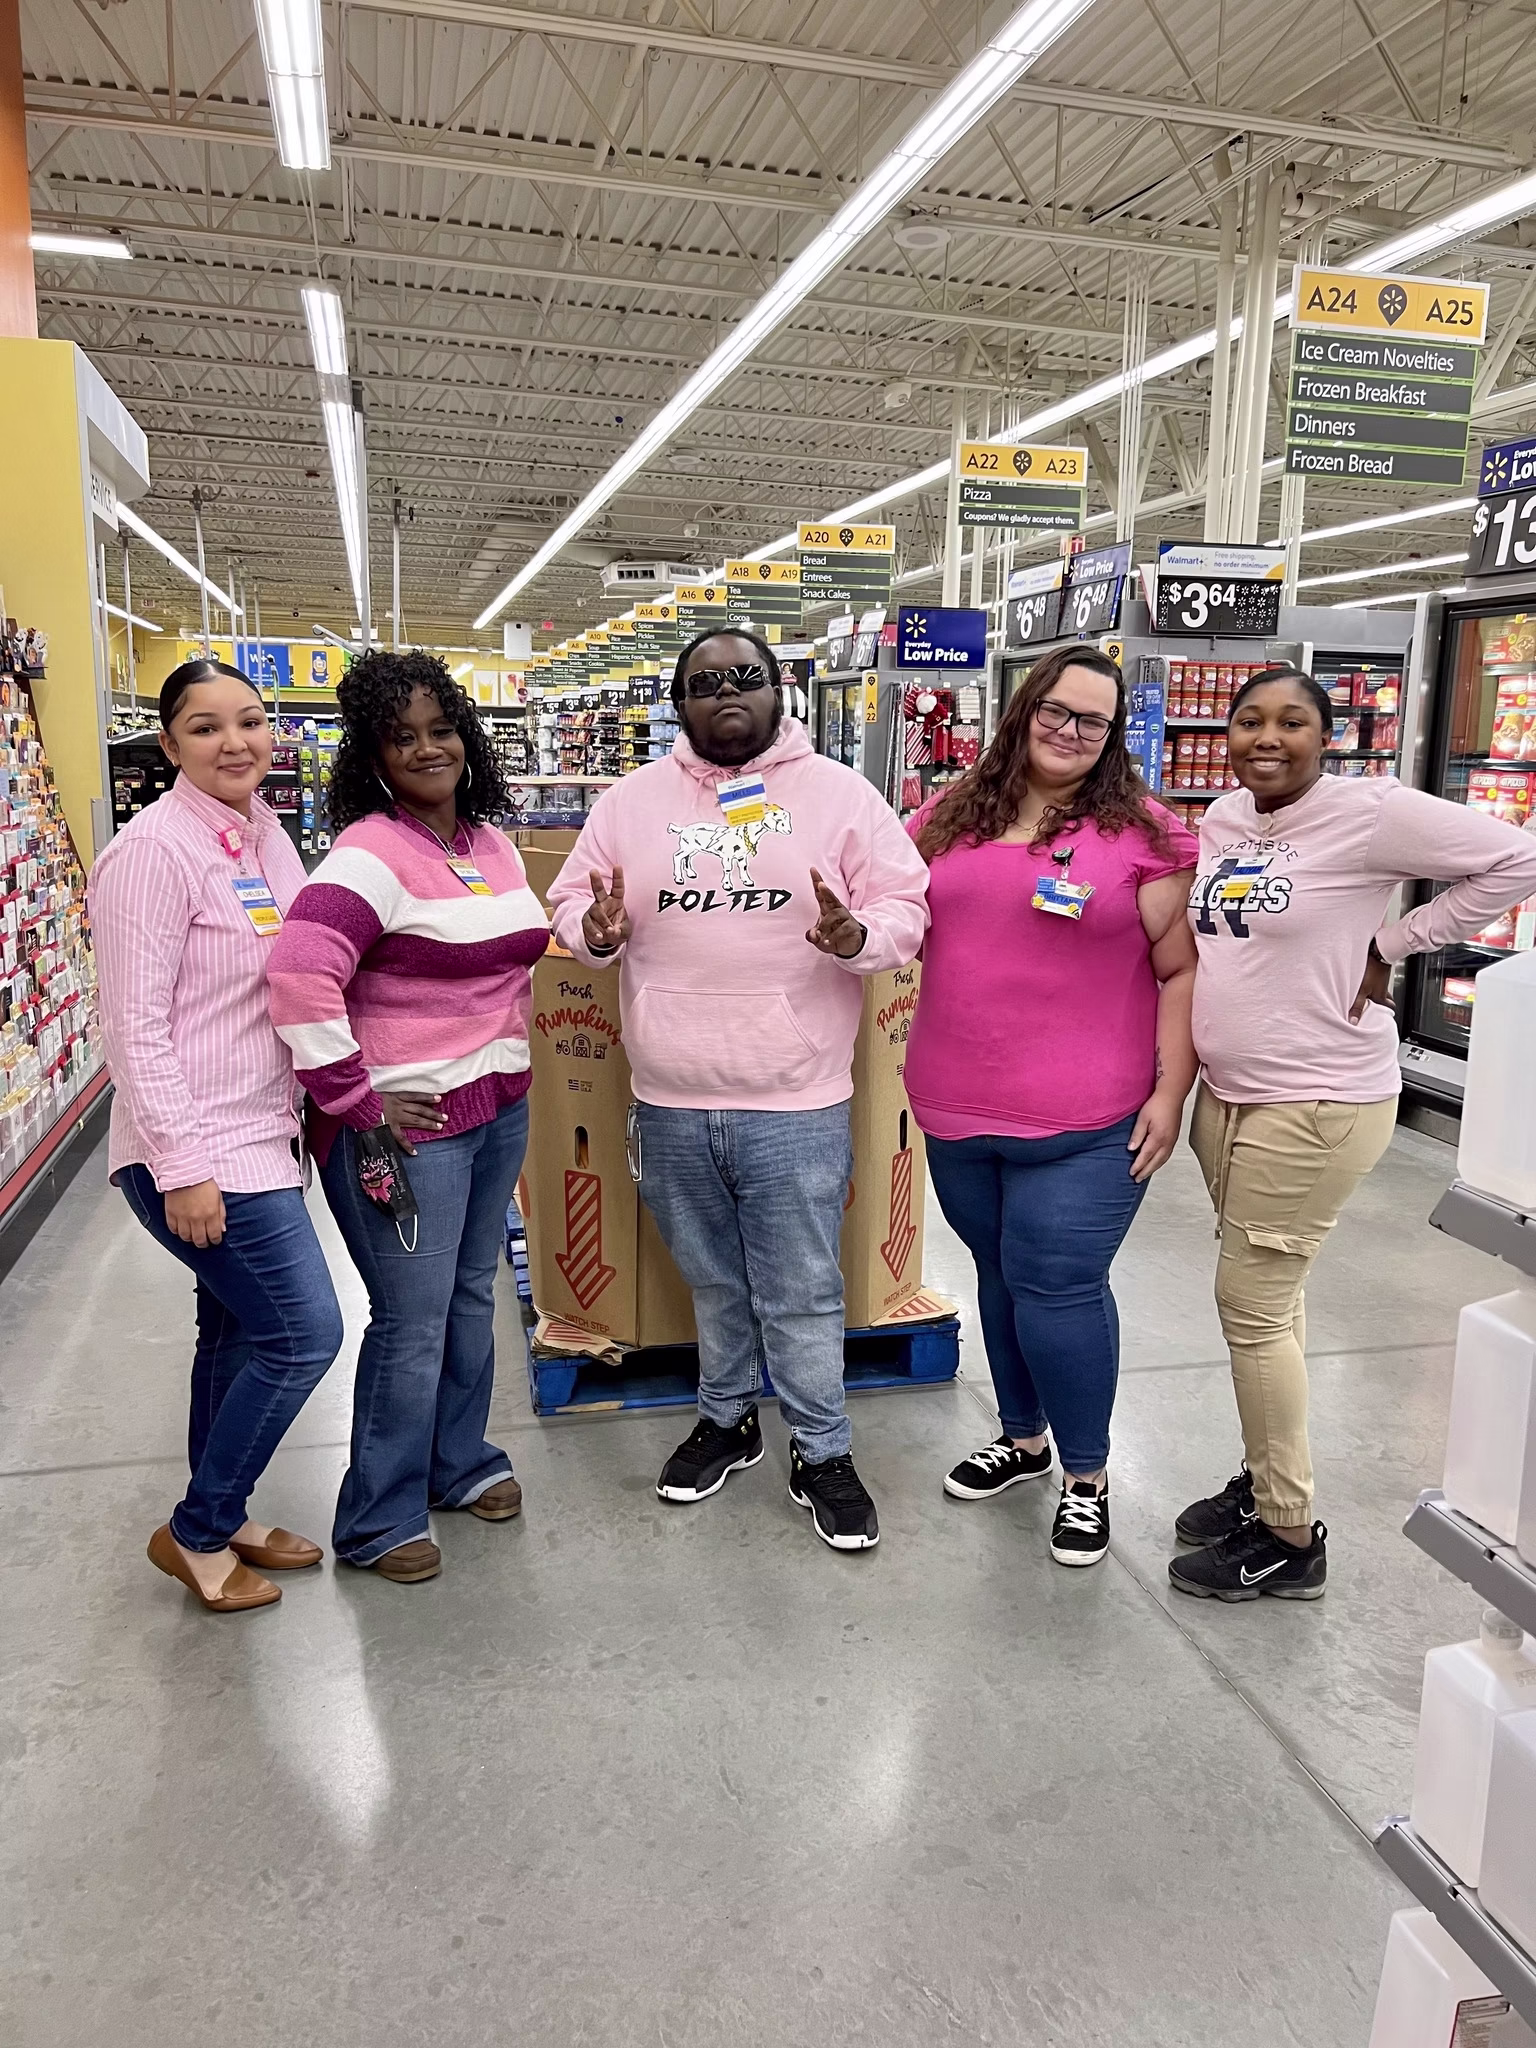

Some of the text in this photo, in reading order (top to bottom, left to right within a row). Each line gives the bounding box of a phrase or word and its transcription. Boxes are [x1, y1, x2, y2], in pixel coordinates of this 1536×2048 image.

[1306, 286, 1474, 325] A24 A25
[1301, 340, 1454, 371] Ice Cream Novelties
[1298, 377, 1426, 405] Frozen Breakfast
[1295, 413, 1356, 436] Dinners
[966, 453, 1076, 474] A22 A23
[1292, 450, 1393, 475] Frozen Bread
[964, 488, 992, 500] Pizza
[964, 512, 996, 521] Coupons?
[1010, 514, 1031, 524] gladly
[1032, 516, 1054, 524] accept
[1055, 516, 1074, 524] them.
[805, 531, 886, 545] A20 A21
[803, 556, 826, 565] Bread
[732, 568, 797, 579] A18 A19
[1080, 561, 1114, 578] Low Price
[803, 573, 832, 582] Entrees
[681, 591, 696, 599] A16
[803, 589, 850, 599] Snack Cakes
[729, 614, 750, 622] Cocoa
[905, 641, 931, 650] Everyday
[904, 649, 968, 662] Low Price
[868, 702, 875, 710] A
[657, 889, 792, 912] BOLTED
[893, 969, 913, 988] Fresh
[557, 981, 593, 999] Fresh
[535, 1004, 621, 1046] Pumpkins
[564, 1313, 609, 1333] WATCH STEP
